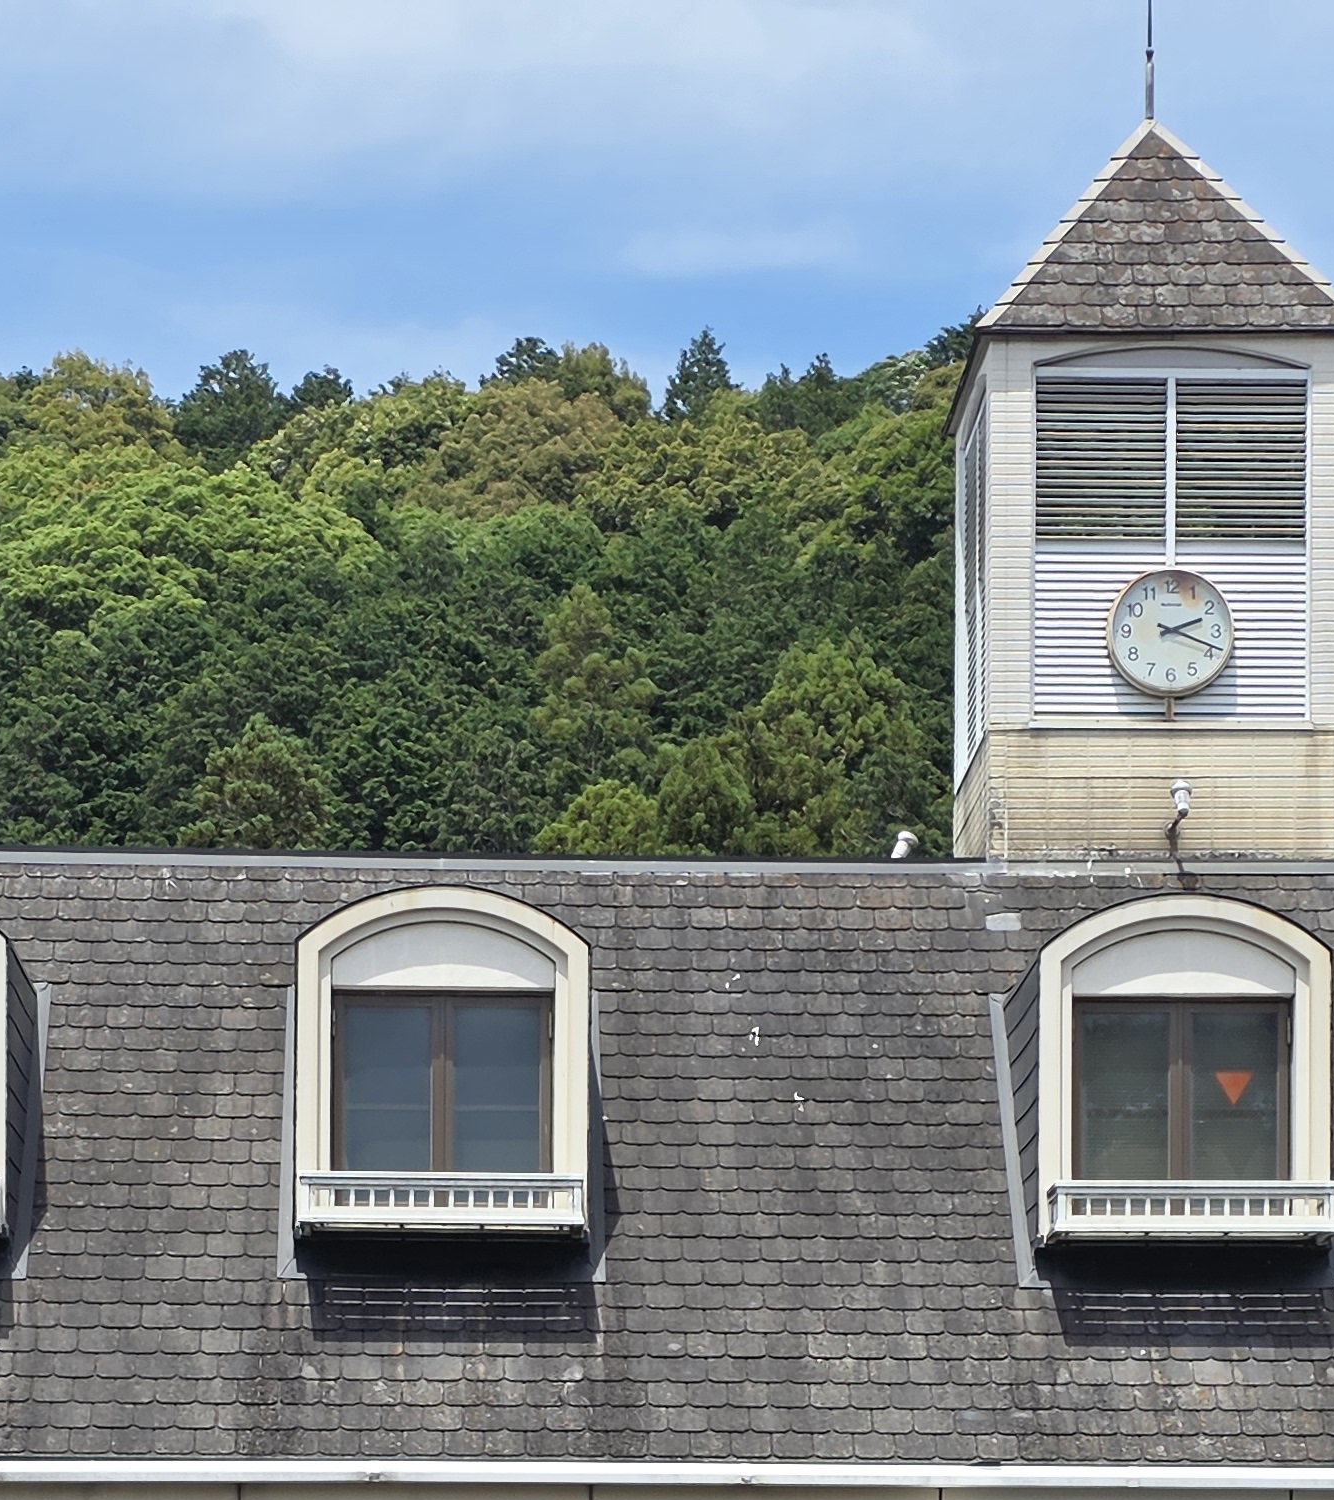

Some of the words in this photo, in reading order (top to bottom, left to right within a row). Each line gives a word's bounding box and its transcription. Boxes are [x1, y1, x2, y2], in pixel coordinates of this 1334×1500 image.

[1143, 586, 1156, 600] 11
[1164, 579, 1180, 593] 12
[1190, 586, 1196, 599] 1
[1128, 602, 1143, 618] 10
[1205, 601, 1215, 615] 2
[1121, 624, 1131, 638] 9
[1211, 624, 1221, 638] 3
[1128, 646, 1139, 661] 8
[1204, 646, 1213, 660] 4
[1146, 663, 1156, 676] 7
[1166, 668, 1176, 682] 6
[1187, 662, 1198, 676] 5
